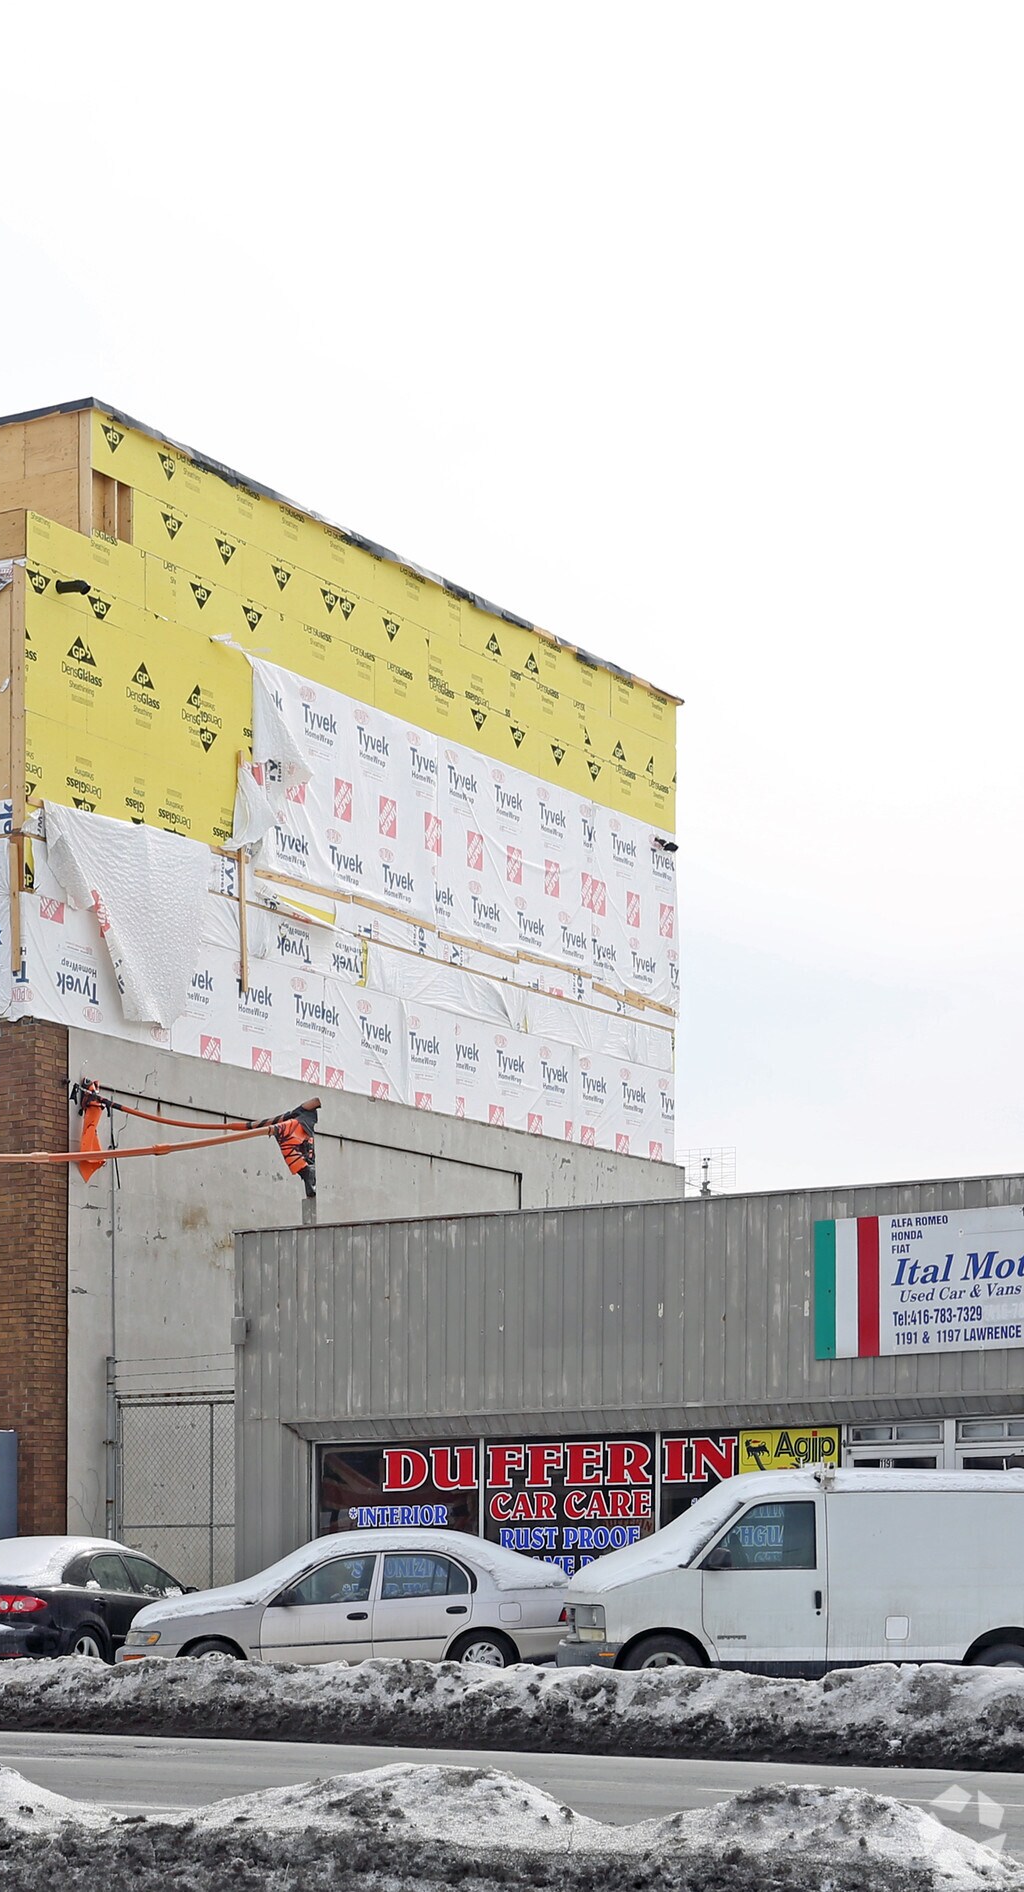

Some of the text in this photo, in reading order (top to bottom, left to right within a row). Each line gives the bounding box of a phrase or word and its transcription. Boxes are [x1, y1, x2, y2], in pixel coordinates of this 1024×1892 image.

[136, 671, 149, 685] GP
[125, 686, 161, 710] DensGlass
[302, 703, 337, 735] Tyvek
[304, 727, 334, 747] HomeWrap
[357, 725, 389, 757] Tyvek
[359, 750, 386, 769] HomeWrap
[65, 775, 102, 799] DensGlass
[447, 765, 477, 794] Tyvek
[494, 784, 523, 812] Tyvek
[158, 807, 192, 831] DensGlass
[539, 802, 566, 829] Tyvek
[274, 826, 309, 856] Tyvek
[611, 833, 636, 858] Tyvek
[329, 845, 363, 875] Tyvek
[382, 863, 414, 892] Tyvek
[471, 896, 500, 923] Tyvek
[517, 911, 544, 937] Tyvek
[561, 926, 587, 950] Tyvek
[61, 957, 97, 978] HomeWrap
[631, 951, 656, 974] Tyvek
[56, 971, 99, 1005] Tyvek
[236, 978, 272, 1008] Tyvek
[238, 1003, 269, 1020] HomeWrap
[359, 1015, 392, 1044] Tyvek
[409, 1031, 440, 1056] Tyvek
[410, 1054, 437, 1067] HomeWrap
[497, 1050, 525, 1074] Tyvek
[541, 1061, 568, 1084] Tyvek
[581, 1072, 607, 1094] Tyvek
[622, 1082, 646, 1104] Tyvek
[891, 1215, 949, 1229] ALFA ROMEO
[891, 1230, 923, 1242] HONDA
[891, 1244, 911, 1254] FIAT
[891, 1254, 954, 1286] Ital
[899, 1283, 1022, 1303] Used Car & Vans
[892, 1305, 982, 1326] Tel:416-783-7329
[895, 1325, 1022, 1345] 1191 & 1197 LAWRENCE
[774, 1430, 836, 1463] Agip
[488, 1490, 652, 1521] CAR CARE
[500, 1528, 558, 1550] RUST
[562, 1525, 641, 1550] PROOF
